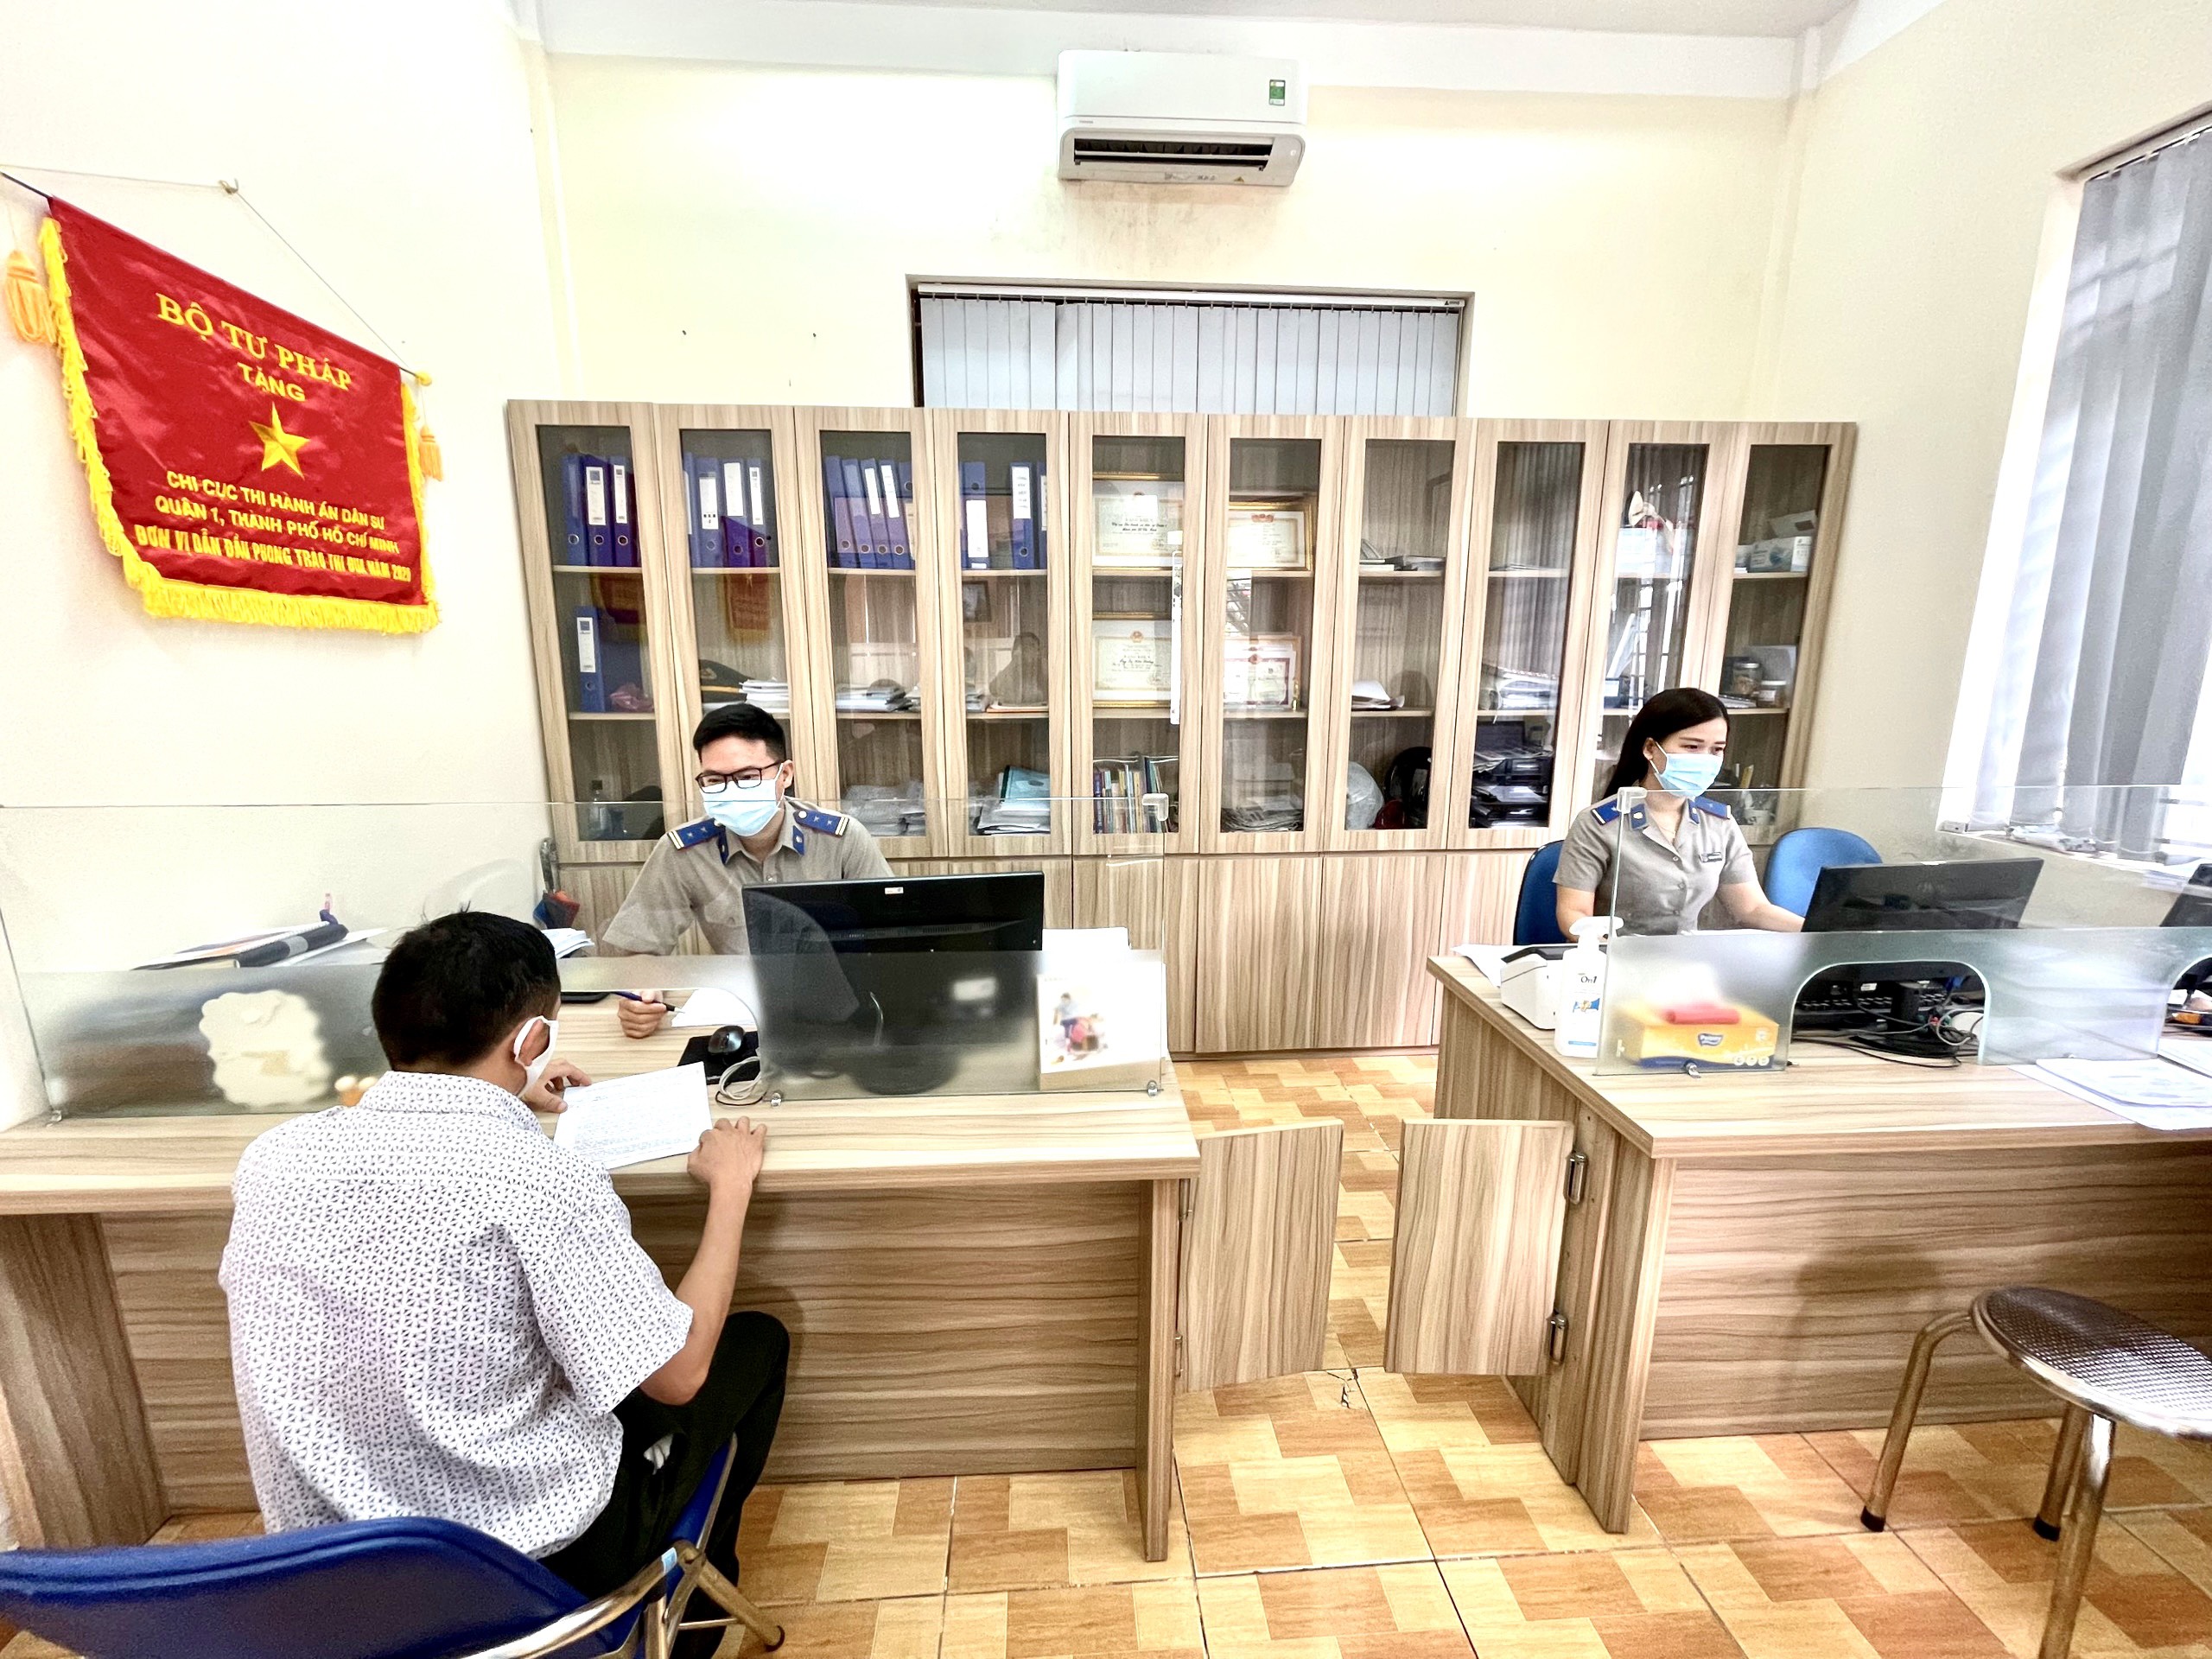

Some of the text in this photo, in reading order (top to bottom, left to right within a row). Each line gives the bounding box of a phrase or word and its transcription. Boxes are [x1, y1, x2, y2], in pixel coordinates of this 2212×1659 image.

[156, 292, 352, 391] BỘ TƯ PHÁP
[237, 361, 306, 402] TẶNG
[155, 495, 207, 521] QUẬN
[211, 507, 225, 526] 1,
[228, 509, 283, 533] THÀNH
[286, 520, 319, 539] PHỐ
[346, 531, 368, 548] CHÍ
[369, 536, 400, 554] MINH
[167, 471, 199, 493] CHI
[239, 486, 266, 506] THI
[270, 492, 315, 516] HÀNH
[319, 501, 339, 520] ÁN
[341, 507, 369, 526] DÂN
[134, 524, 171, 549] ĐƠN
[175, 530, 192, 556] VỊ
[251, 542, 294, 565] PHONG
[327, 553, 346, 572] THI
